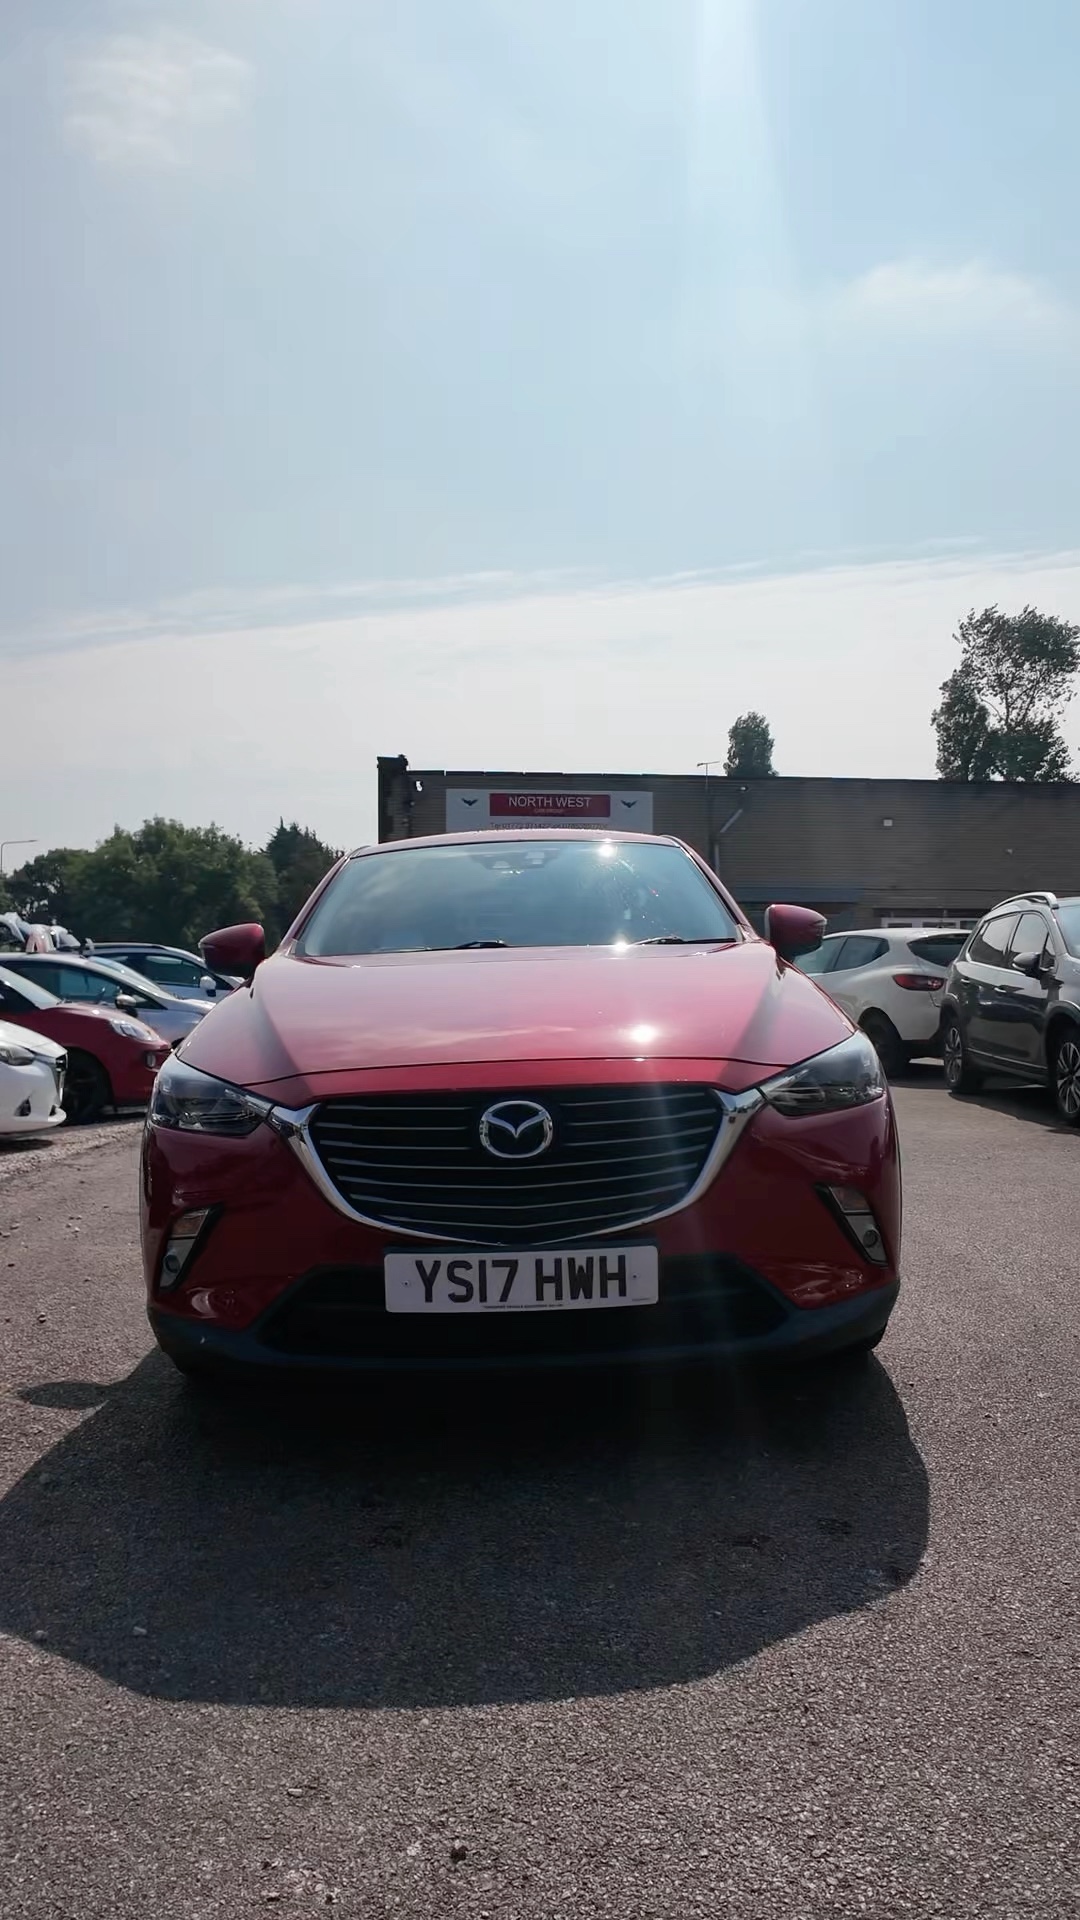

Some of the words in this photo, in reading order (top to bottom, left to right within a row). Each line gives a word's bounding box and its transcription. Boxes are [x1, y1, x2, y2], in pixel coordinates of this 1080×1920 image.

[508, 796, 553, 807] NORTH
[555, 796, 592, 808] WEST
[415, 1259, 519, 1303] YS17
[535, 1255, 627, 1302] HWH
